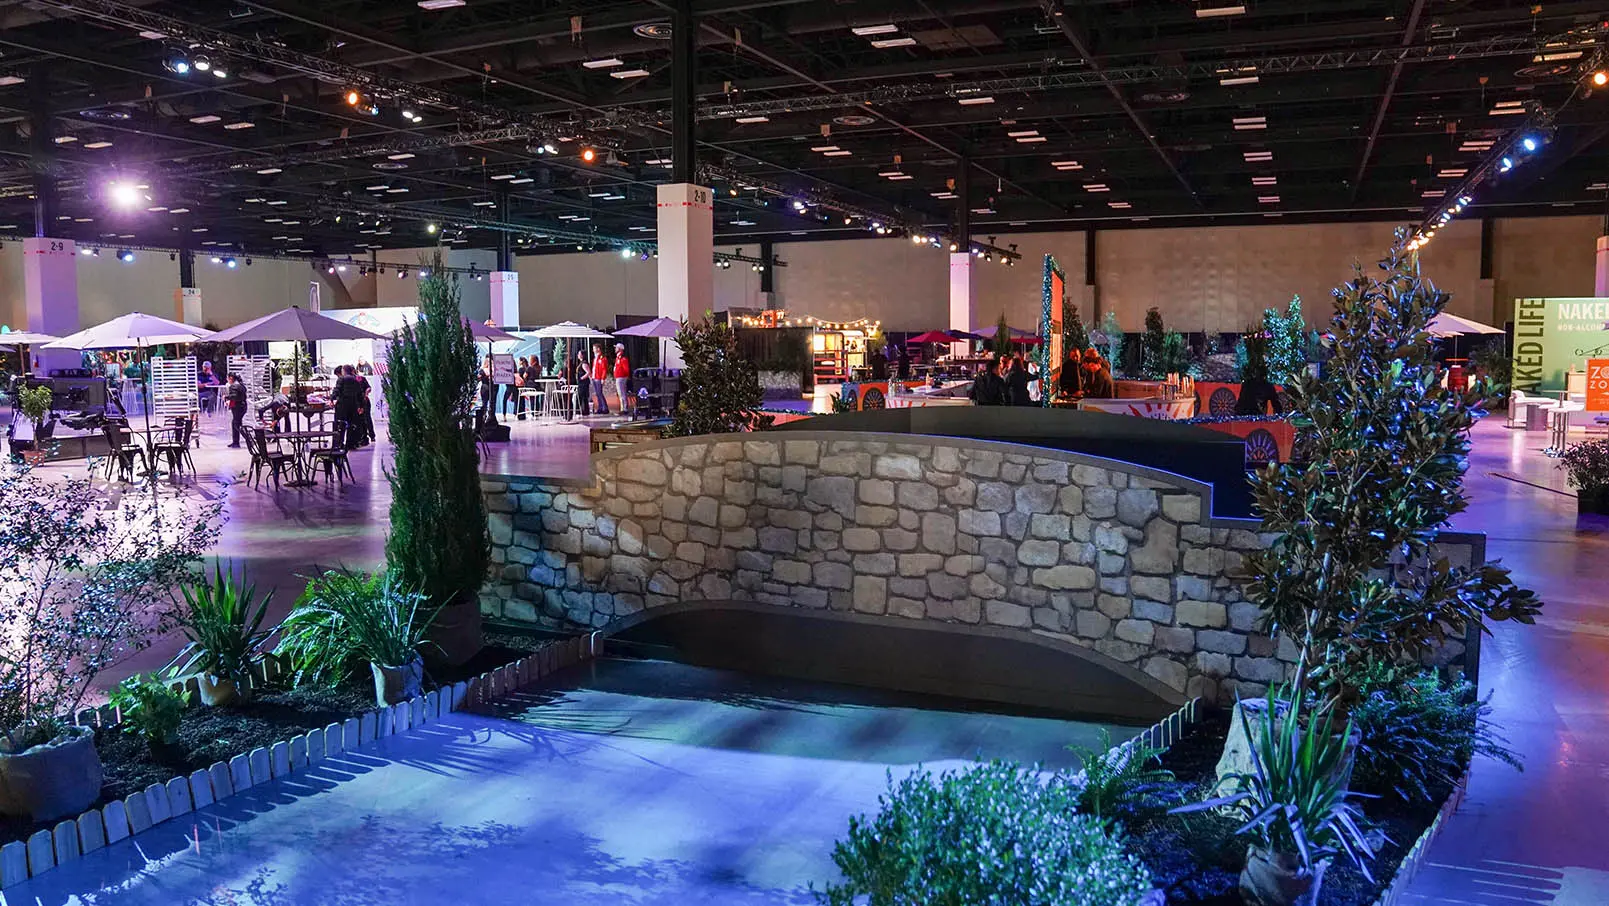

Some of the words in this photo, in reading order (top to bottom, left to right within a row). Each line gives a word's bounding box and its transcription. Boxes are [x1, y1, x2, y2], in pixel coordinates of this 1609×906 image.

[694, 189, 707, 204] 2-10
[51, 241, 64, 251] 2-9
[1517, 299, 1545, 337] LIFE
[1515, 341, 1544, 396] AKED
